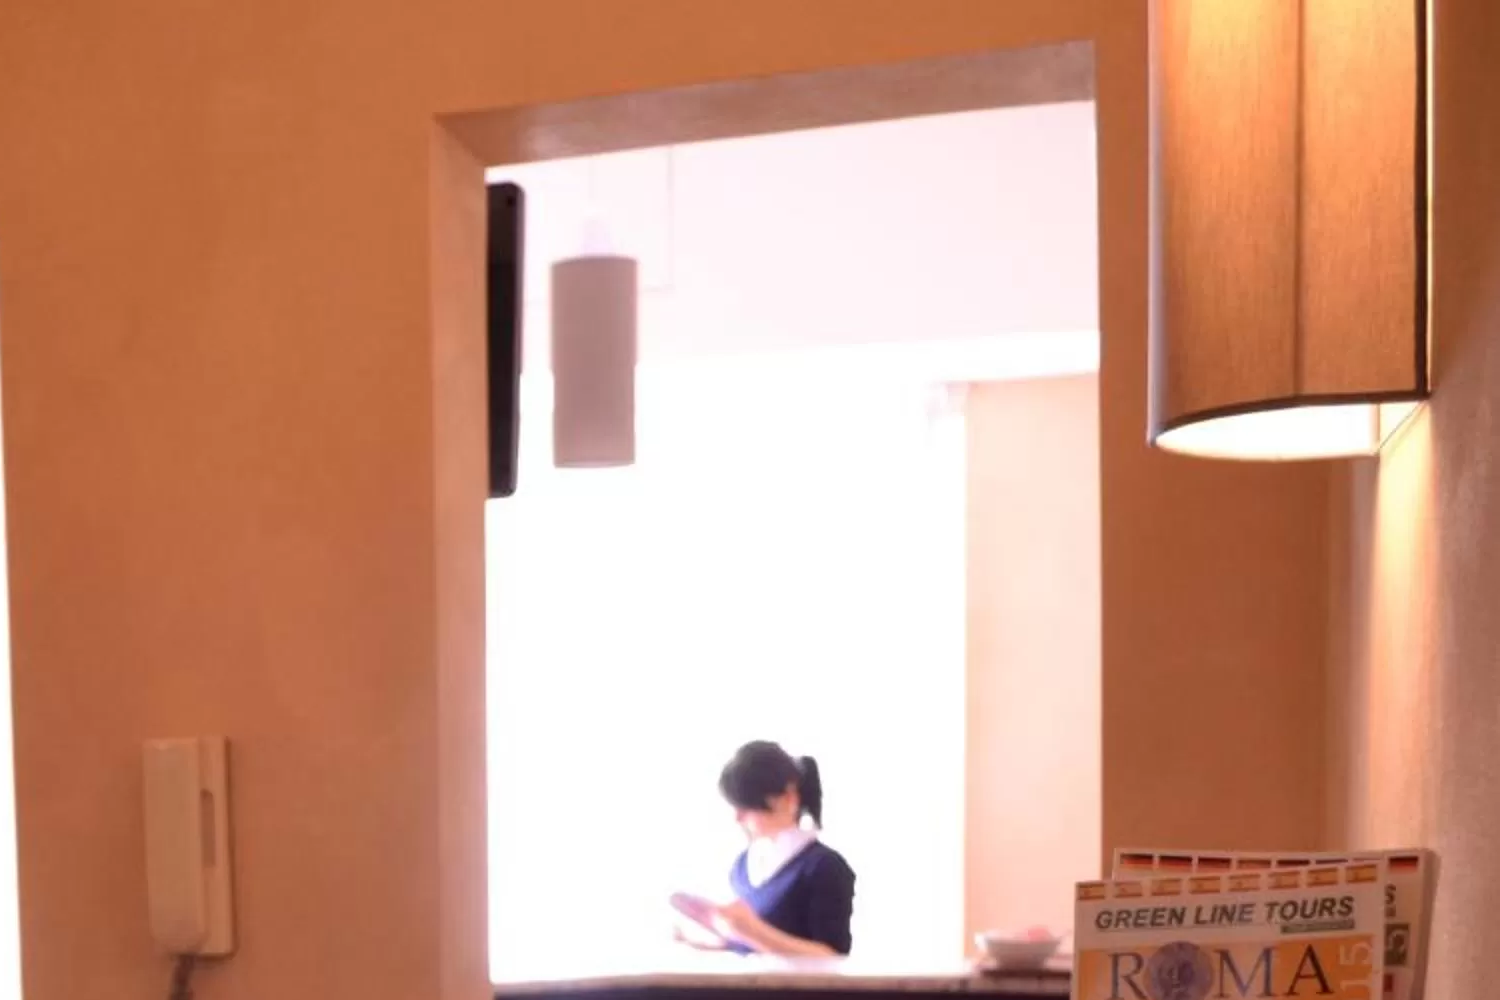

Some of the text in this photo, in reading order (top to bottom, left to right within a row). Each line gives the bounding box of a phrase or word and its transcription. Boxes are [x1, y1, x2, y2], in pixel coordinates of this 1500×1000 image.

[1095, 896, 1354, 930] GREEN LINE TOURS
